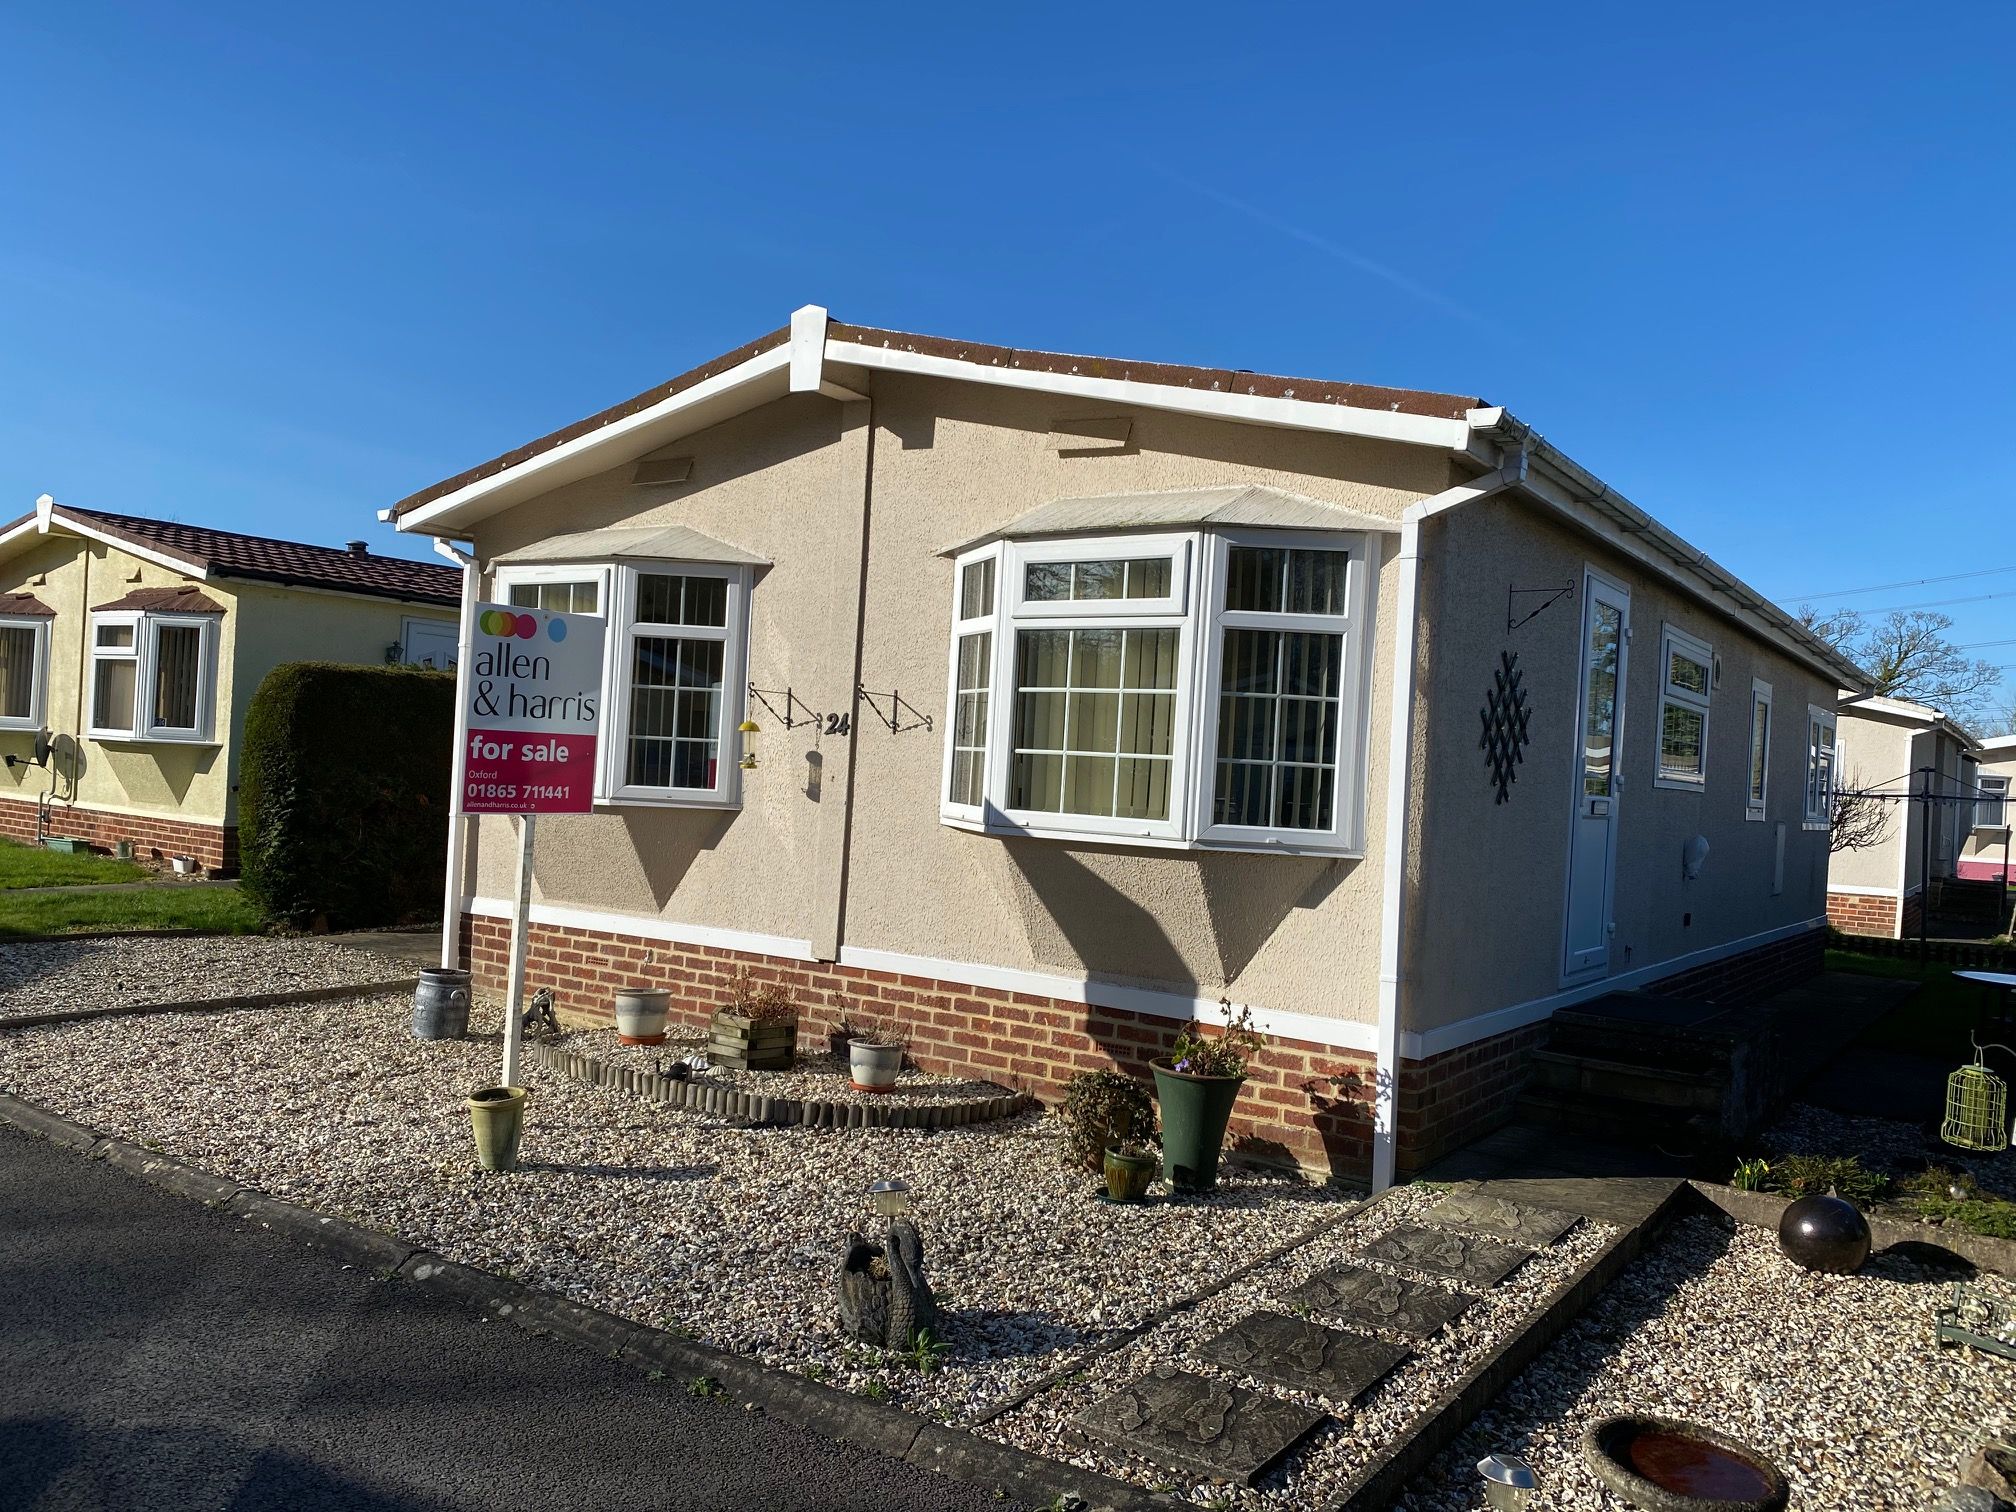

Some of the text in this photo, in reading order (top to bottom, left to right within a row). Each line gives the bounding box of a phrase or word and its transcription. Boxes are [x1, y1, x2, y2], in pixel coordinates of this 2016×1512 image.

[475, 642, 549, 680] allen
[474, 680, 595, 721] & harris
[824, 713, 850, 736] 24
[470, 735, 569, 762] for sale
[468, 770, 497, 779] Oxford
[467, 783, 570, 799] 01865 711441
[466, 800, 527, 809] allenandharris.co.uk
